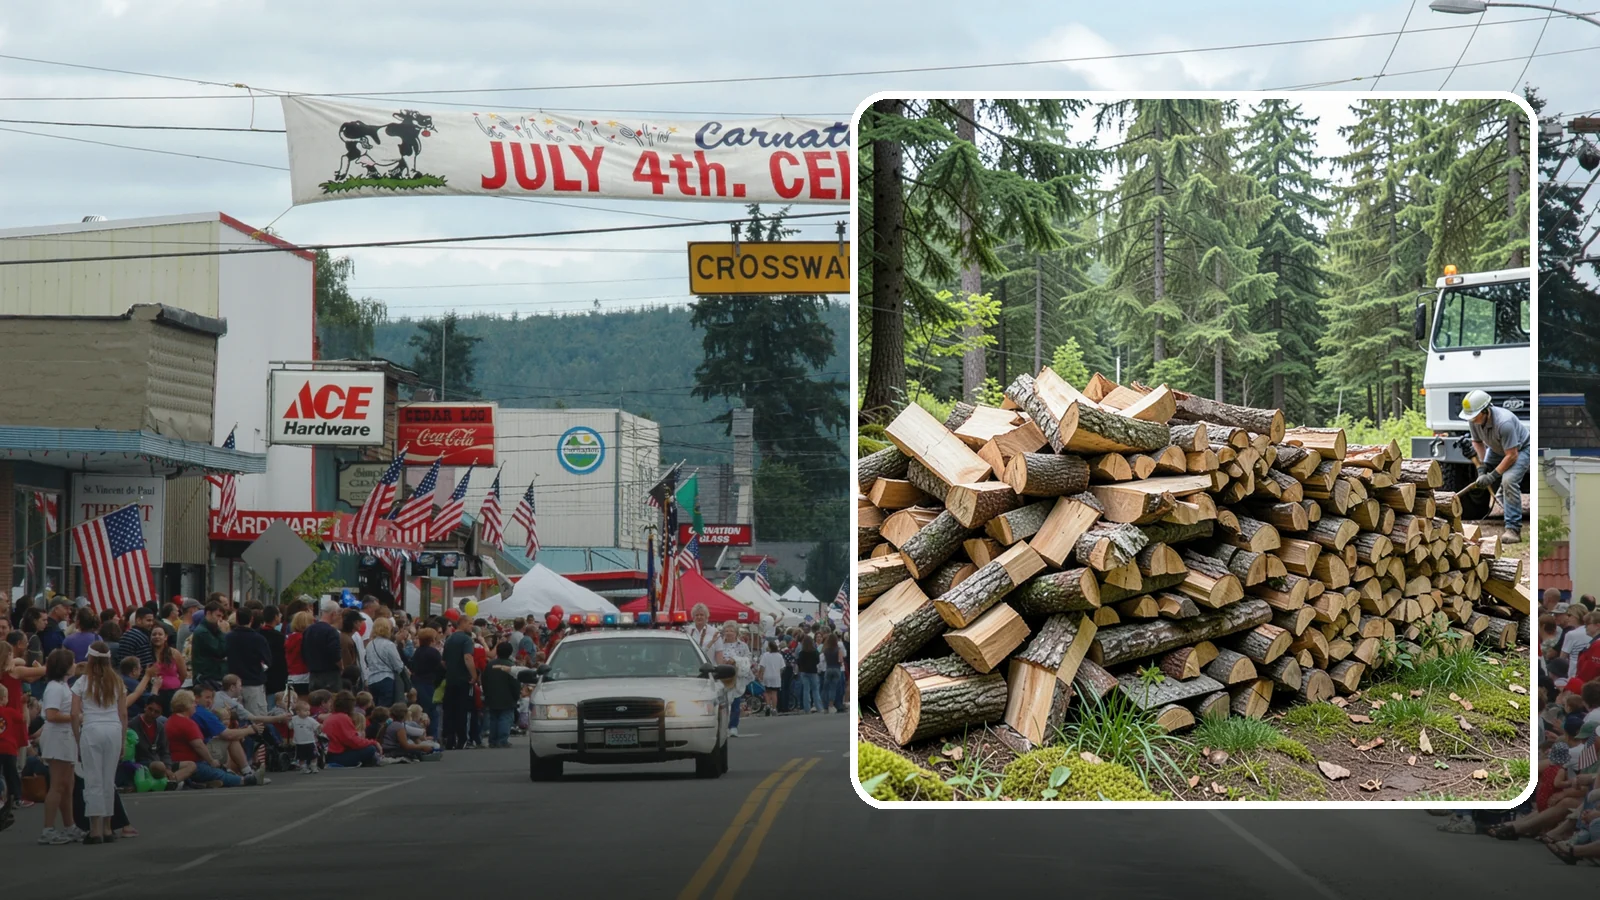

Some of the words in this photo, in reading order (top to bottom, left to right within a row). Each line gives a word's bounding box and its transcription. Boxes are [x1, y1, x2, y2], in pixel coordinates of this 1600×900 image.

[694, 121, 850, 150] Carnat
[481, 141, 605, 193] JULY
[632, 149, 747, 198] 4th.
[697, 254, 850, 280] CROSSWA
[282, 380, 373, 420] ACE
[406, 409, 453, 422] CEDAR
[283, 420, 371, 436] Hardware
[416, 428, 477, 447] Coca-Cola
[353, 467, 387, 481] Simpl
[83, 484, 93, 494] St.
[96, 485, 124, 495] Vincent
[126, 486, 136, 495] de
[138, 486, 155, 495] Paul
[688, 526, 741, 535] CRNATION
[699, 535, 730, 543] GLASS
